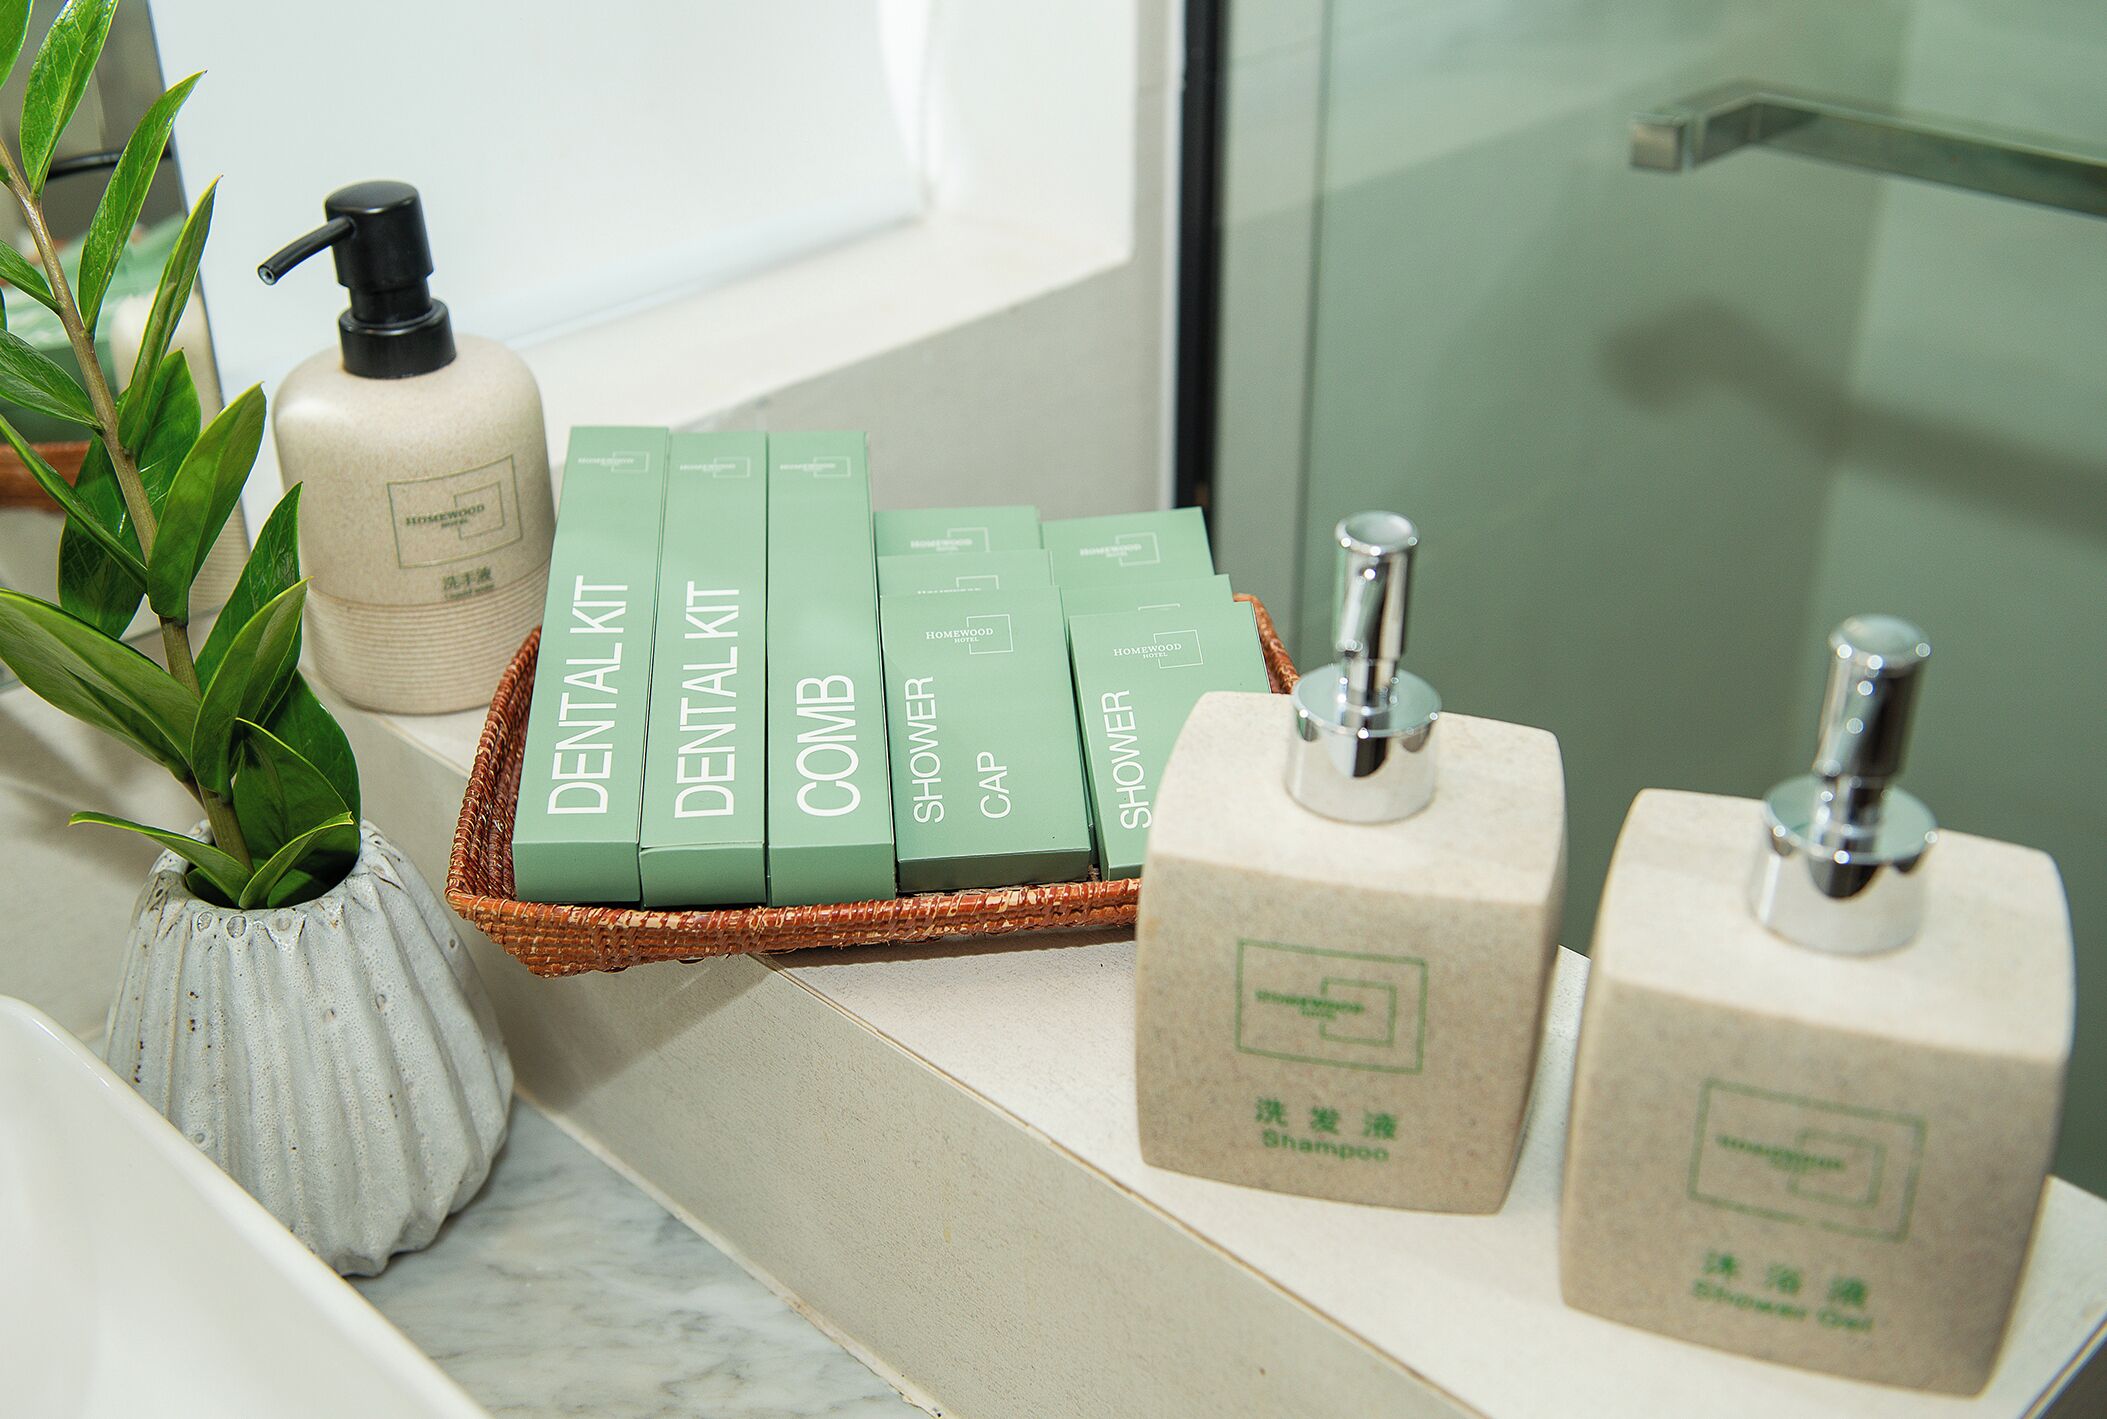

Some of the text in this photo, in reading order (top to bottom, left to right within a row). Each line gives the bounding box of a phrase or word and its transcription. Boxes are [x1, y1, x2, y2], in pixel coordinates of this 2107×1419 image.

[406, 504, 485, 526] HOMEWOOD
[926, 627, 993, 640] HOMEWOOD
[1113, 643, 1182, 657] HOMEWOOD
[547, 575, 628, 815] DENTAL KIT
[674, 581, 740, 819] DENTAL KIT
[796, 674, 861, 817] COMB
[904, 676, 945, 823] SHOWER
[1101, 690, 1152, 830] SHOWER
[976, 751, 1012, 819] CAP
[1255, 1098, 1398, 1140] 洗发液
[1262, 1129, 1389, 1161] Shampoo
